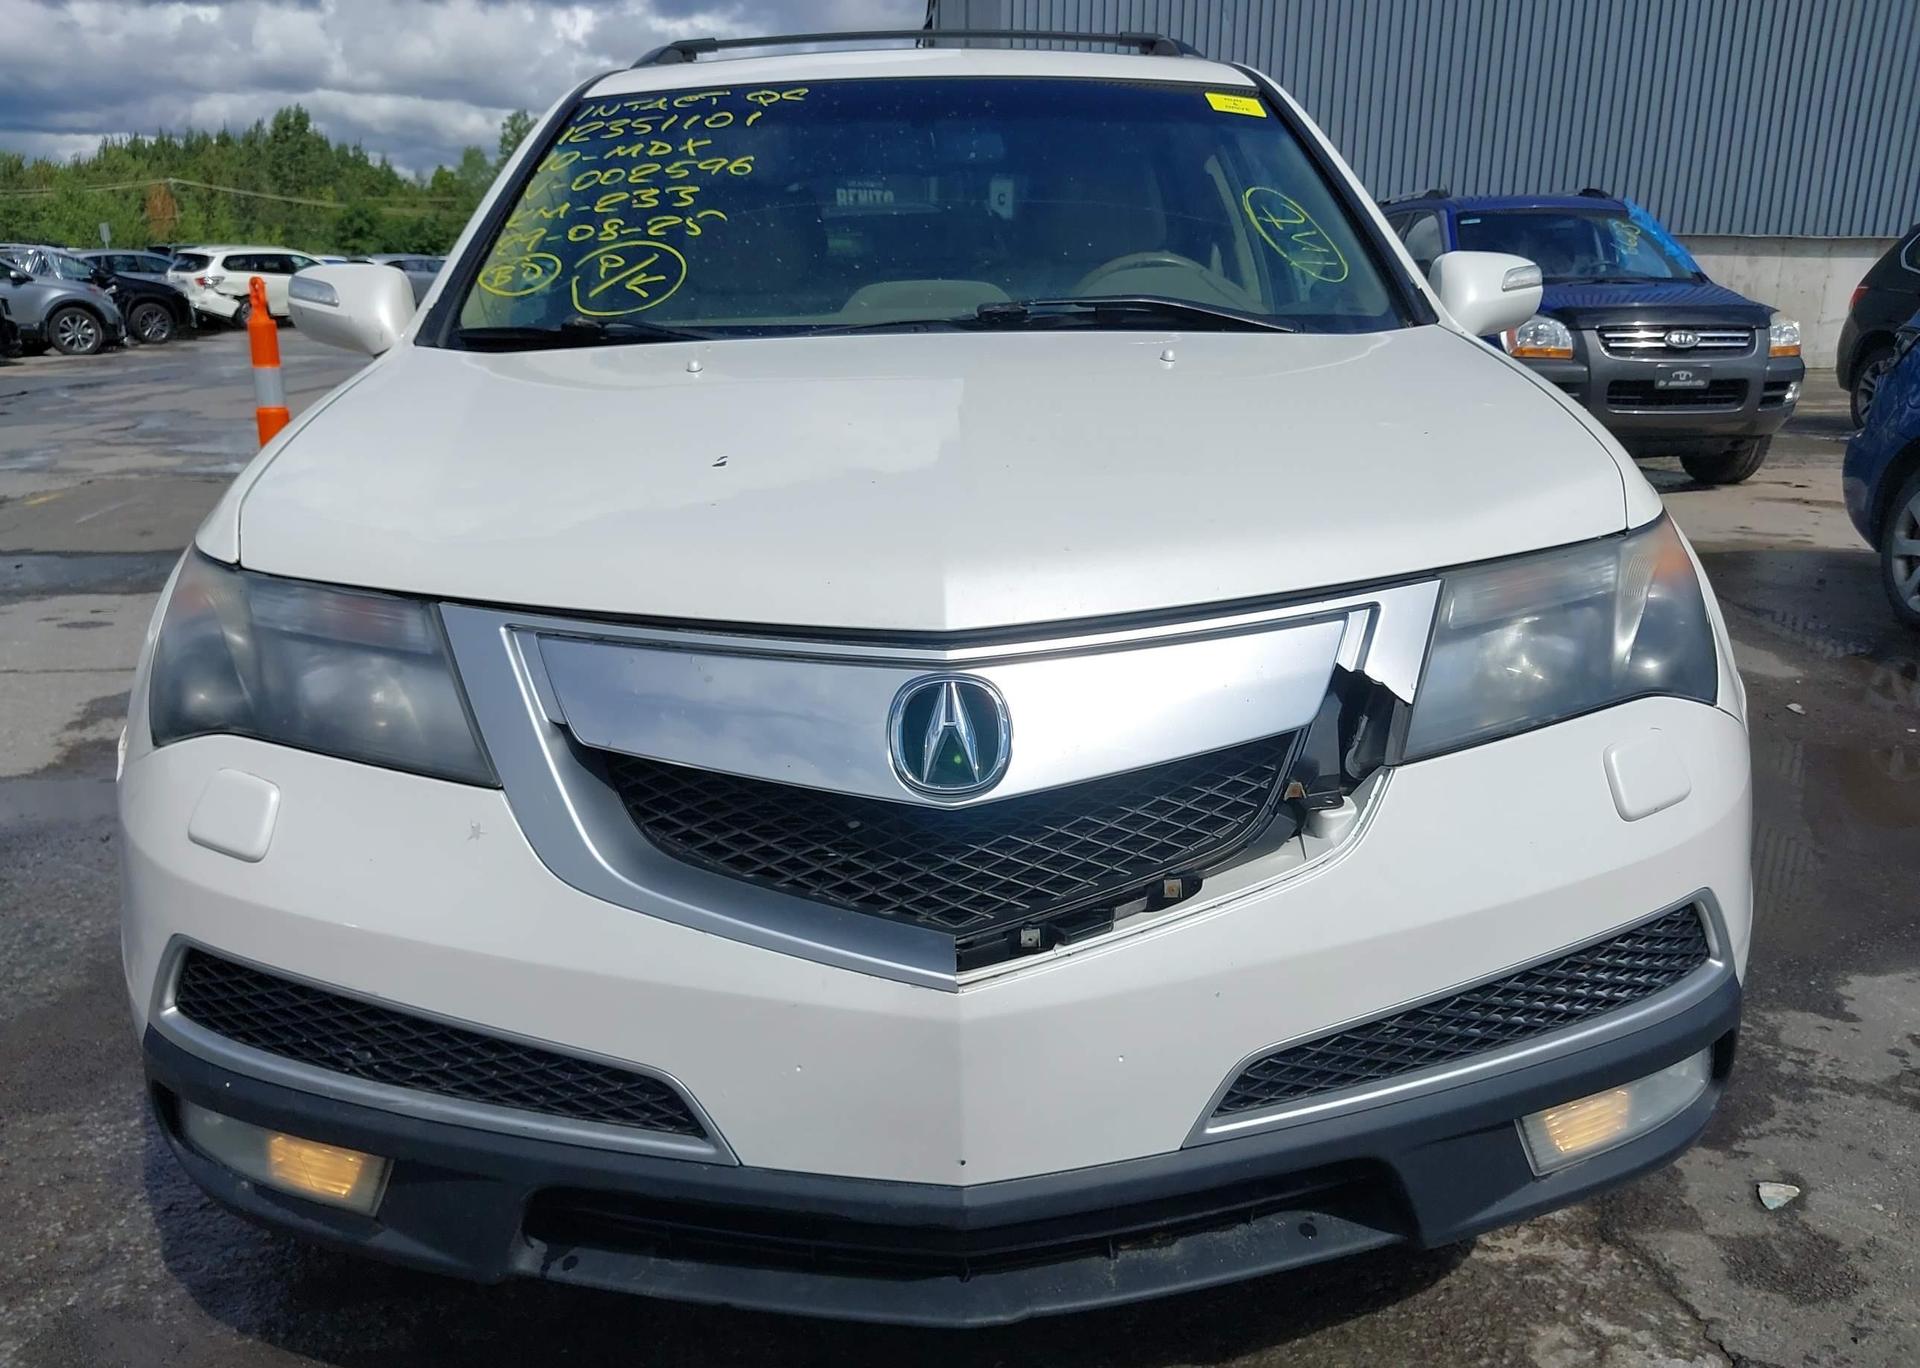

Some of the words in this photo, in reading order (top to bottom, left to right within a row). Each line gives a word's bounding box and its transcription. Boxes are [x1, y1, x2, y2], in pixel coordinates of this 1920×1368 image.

[576, 91, 731, 122] INTACT
[557, 110, 762, 145] 12351101
[1670, 334, 1694, 344] KIA
